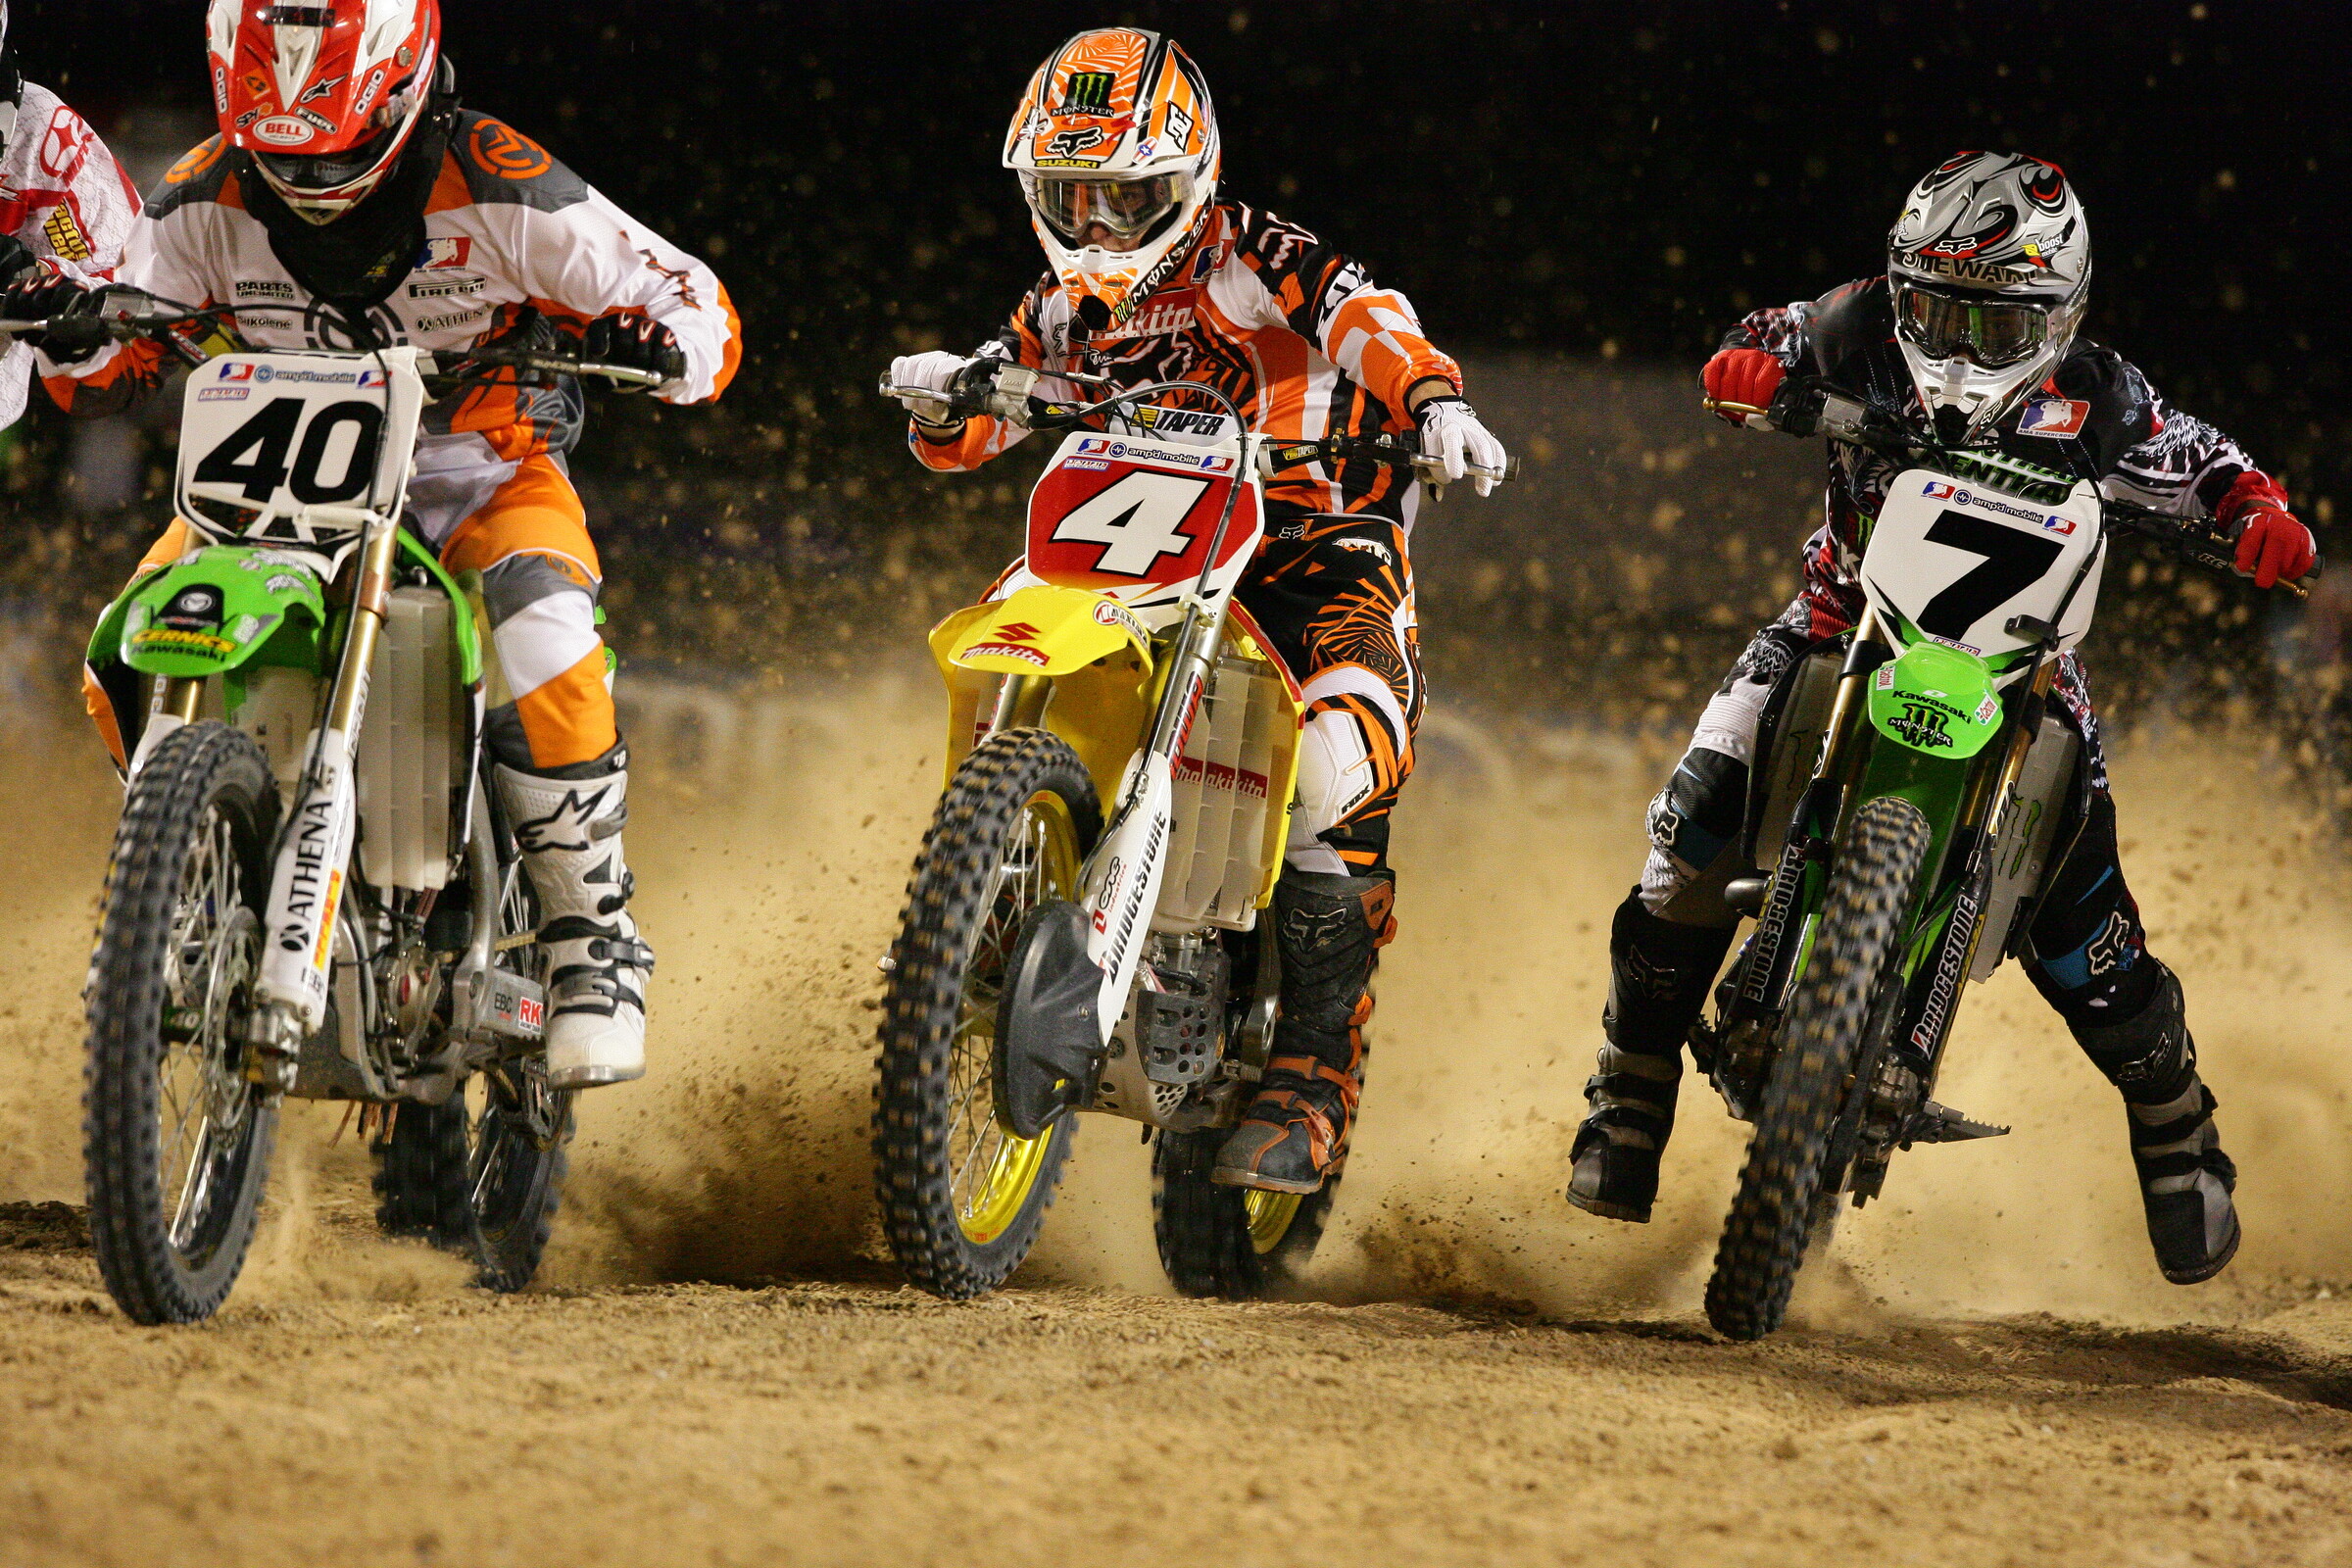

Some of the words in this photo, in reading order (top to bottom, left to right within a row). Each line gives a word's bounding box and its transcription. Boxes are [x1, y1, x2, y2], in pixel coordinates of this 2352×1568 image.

[215, 67, 228, 114] OGIO
[354, 69, 385, 116] OGIO
[266, 122, 303, 136] BELL
[1036, 158, 1099, 170] SUZUKI
[2035, 234, 2065, 253] boost
[235, 281, 293, 293] PARTS
[1154, 410, 1226, 437] TAPER
[192, 398, 387, 505] 40
[1161, 454, 1200, 466] mobile
[1051, 466, 1214, 578] 4
[1972, 497, 2006, 512] amp'd
[2006, 505, 2044, 524] mobile
[1916, 509, 2066, 642] 7
[961, 645, 1048, 669] makita
[1892, 690, 1972, 724] Kawasaki
[1889, 718, 1951, 747] MONSTER
[1342, 784, 1370, 815] FOX
[287, 800, 332, 919] ATHENA
[1101, 810, 1166, 988] BRIDGESTONE
[1910, 893, 1979, 1061] BRIDGESTONE
[494, 992, 513, 1013] EBC
[519, 998, 543, 1026] RK
